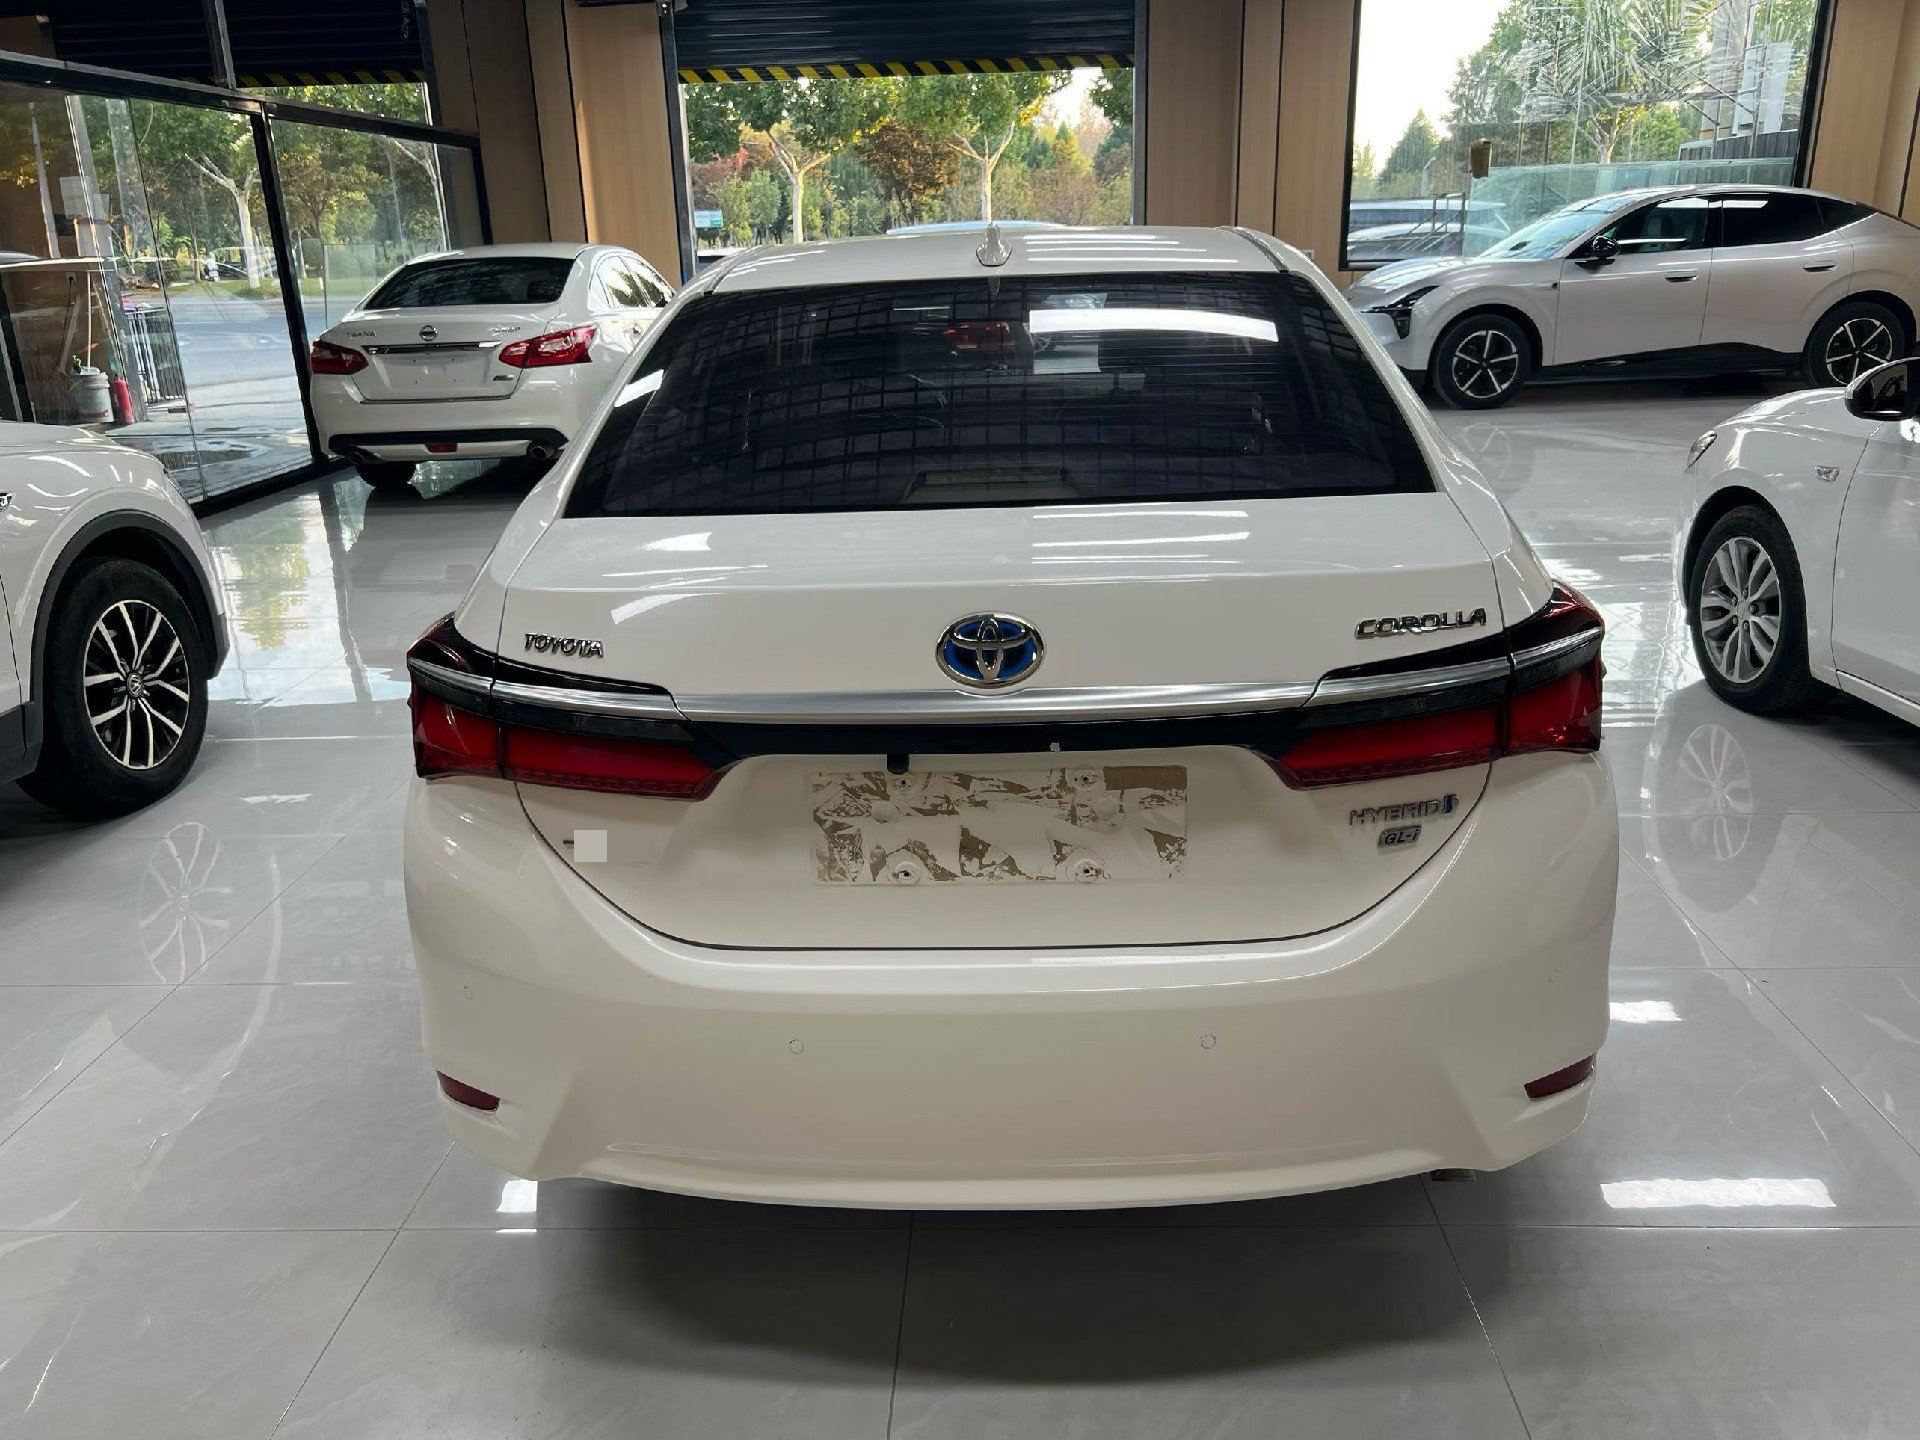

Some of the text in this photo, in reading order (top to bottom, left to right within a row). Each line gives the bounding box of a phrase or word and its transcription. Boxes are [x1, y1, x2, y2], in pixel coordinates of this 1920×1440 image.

[1355, 607, 1487, 640] COROLLA
[525, 632, 604, 659] TOYOTA
[1349, 799, 1441, 825] HYBRID
[1384, 828, 1419, 845] GL-i
